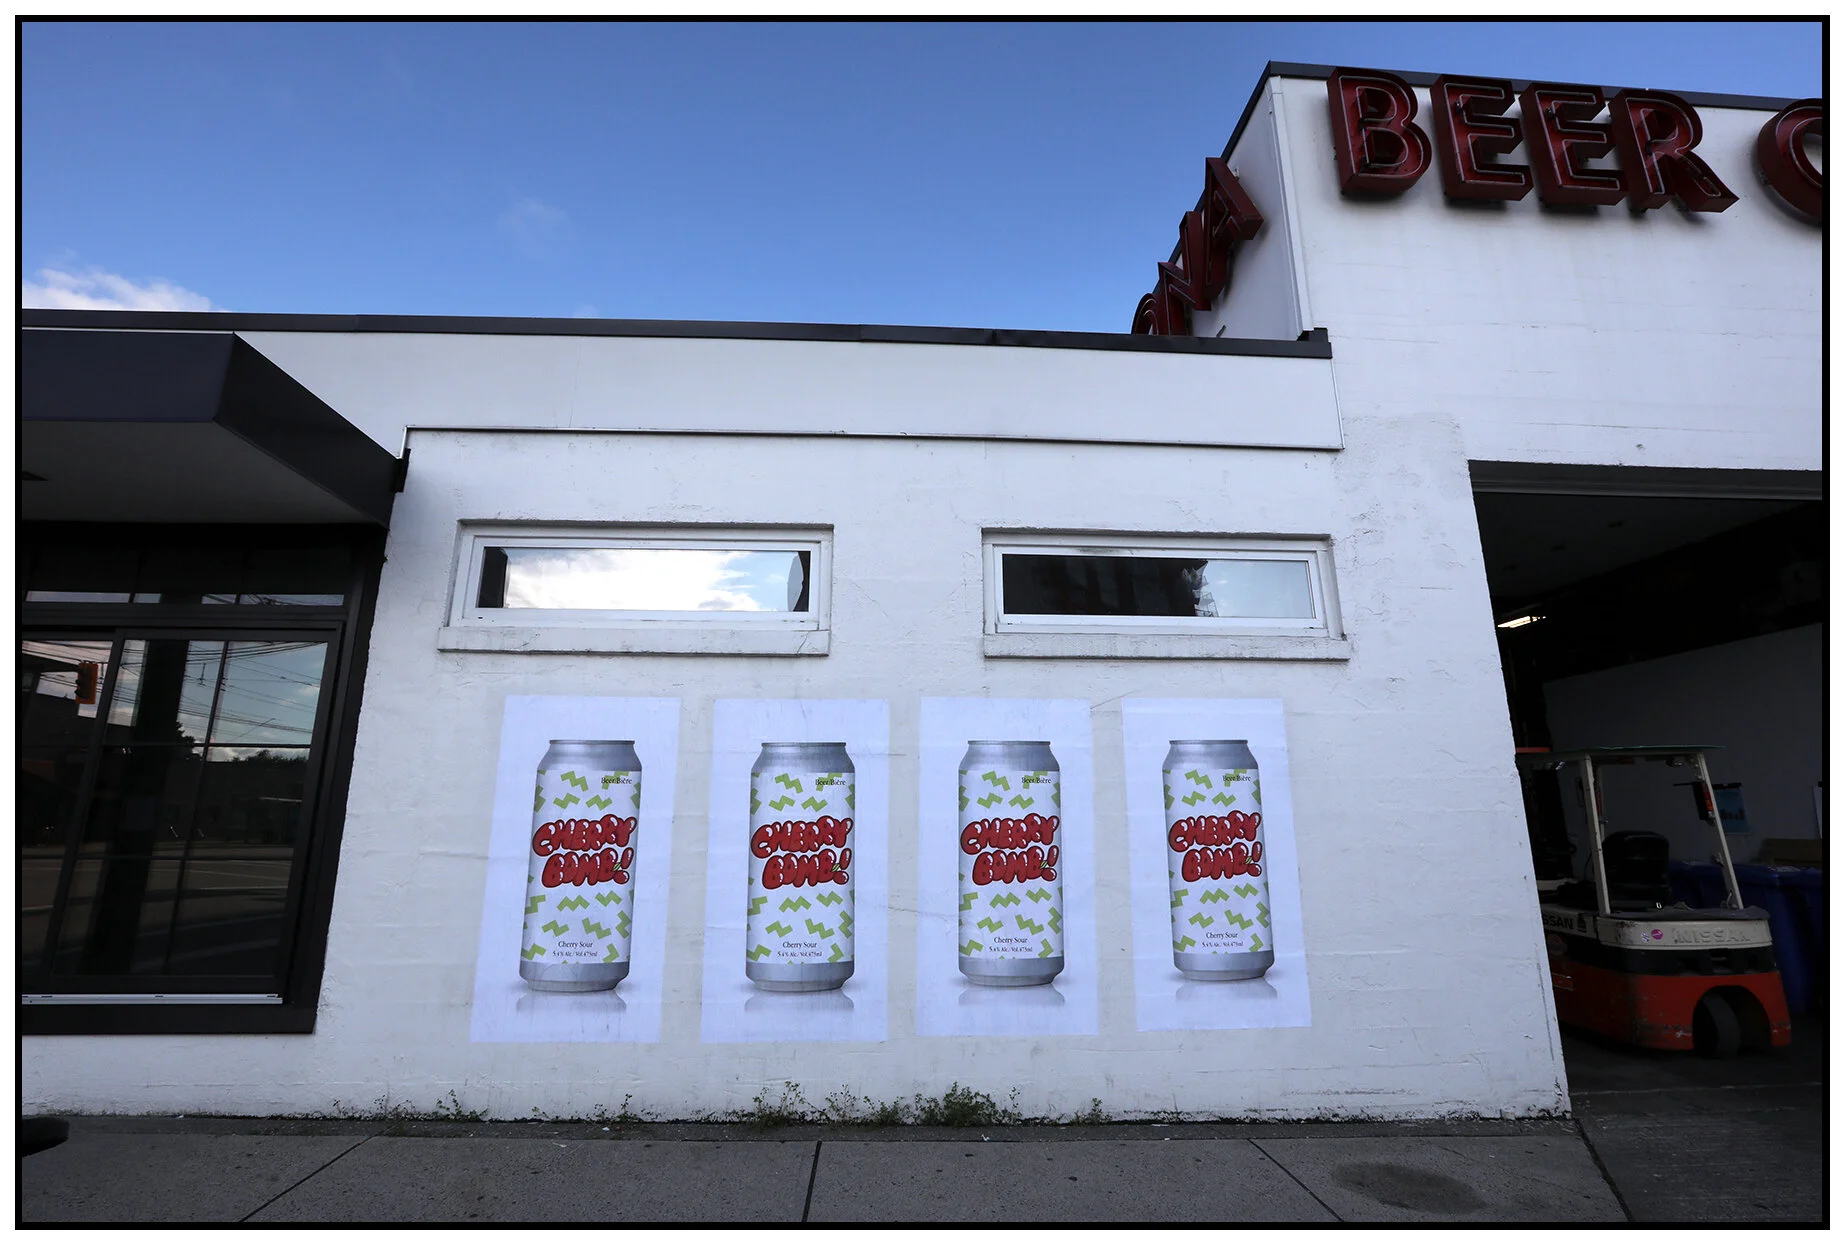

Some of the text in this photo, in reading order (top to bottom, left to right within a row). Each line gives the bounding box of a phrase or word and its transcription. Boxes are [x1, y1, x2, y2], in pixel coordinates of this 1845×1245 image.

[1327, 67, 1739, 213] BEER
[532, 814, 638, 857] CHERRY
[751, 815, 853, 858] CHERRY
[960, 812, 1060, 855] CHERRY
[1167, 810, 1262, 852] CHERRY
[1542, 911, 1574, 930] SSAN
[558, 940, 593, 949] Cherry Sour
[782, 941, 802, 950] Cherry
[993, 936, 1028, 945] Cherry Sour
[1205, 932, 1224, 940] Cherry
